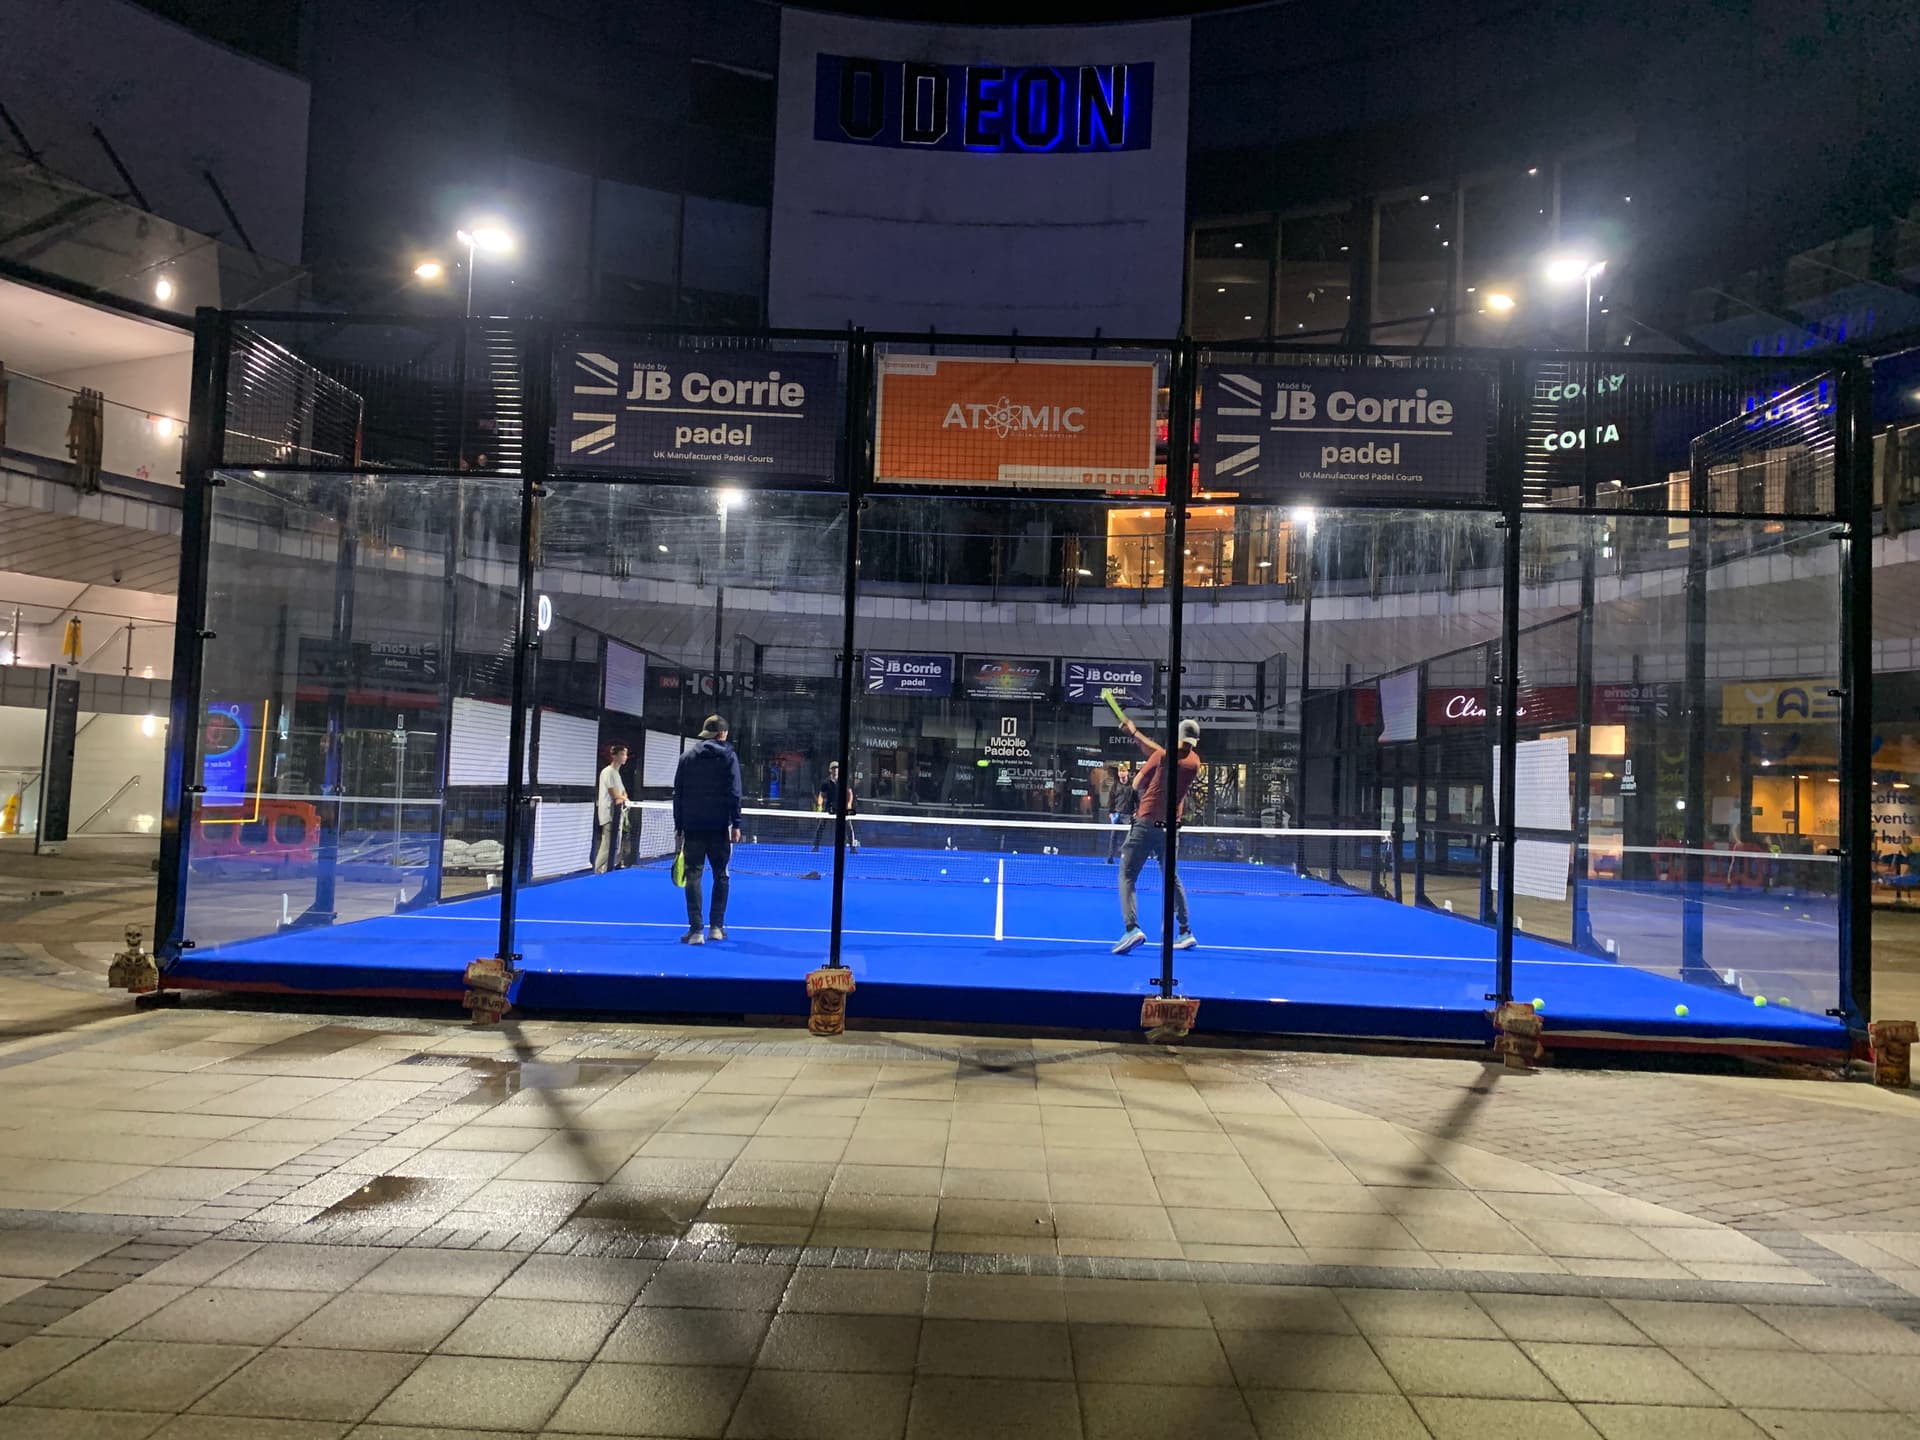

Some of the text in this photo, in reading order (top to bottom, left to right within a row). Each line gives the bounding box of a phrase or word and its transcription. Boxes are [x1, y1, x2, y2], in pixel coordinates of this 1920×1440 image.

[839, 62, 1128, 147] ODEON
[633, 362, 667, 371] Made by
[626, 371, 805, 407] JB Corrie
[1277, 382, 1311, 391] Made by
[1271, 388, 1453, 424] JB Corrie
[942, 400, 1085, 437] ATOMIC
[675, 423, 752, 448] padel
[653, 451, 774, 463] UK Manufactured Padel Courts
[1321, 442, 1400, 468] padel
[1313, 472, 1369, 481] Manufactured
[1372, 473, 1394, 481] Padel
[1396, 473, 1422, 482] Courts
[886, 662, 942, 674] JB Corrie
[1086, 669, 1142, 682] JB Corrie
[901, 678, 926, 687] padel
[991, 737, 1026, 748] Mobile
[984, 746, 1014, 757] Padel
